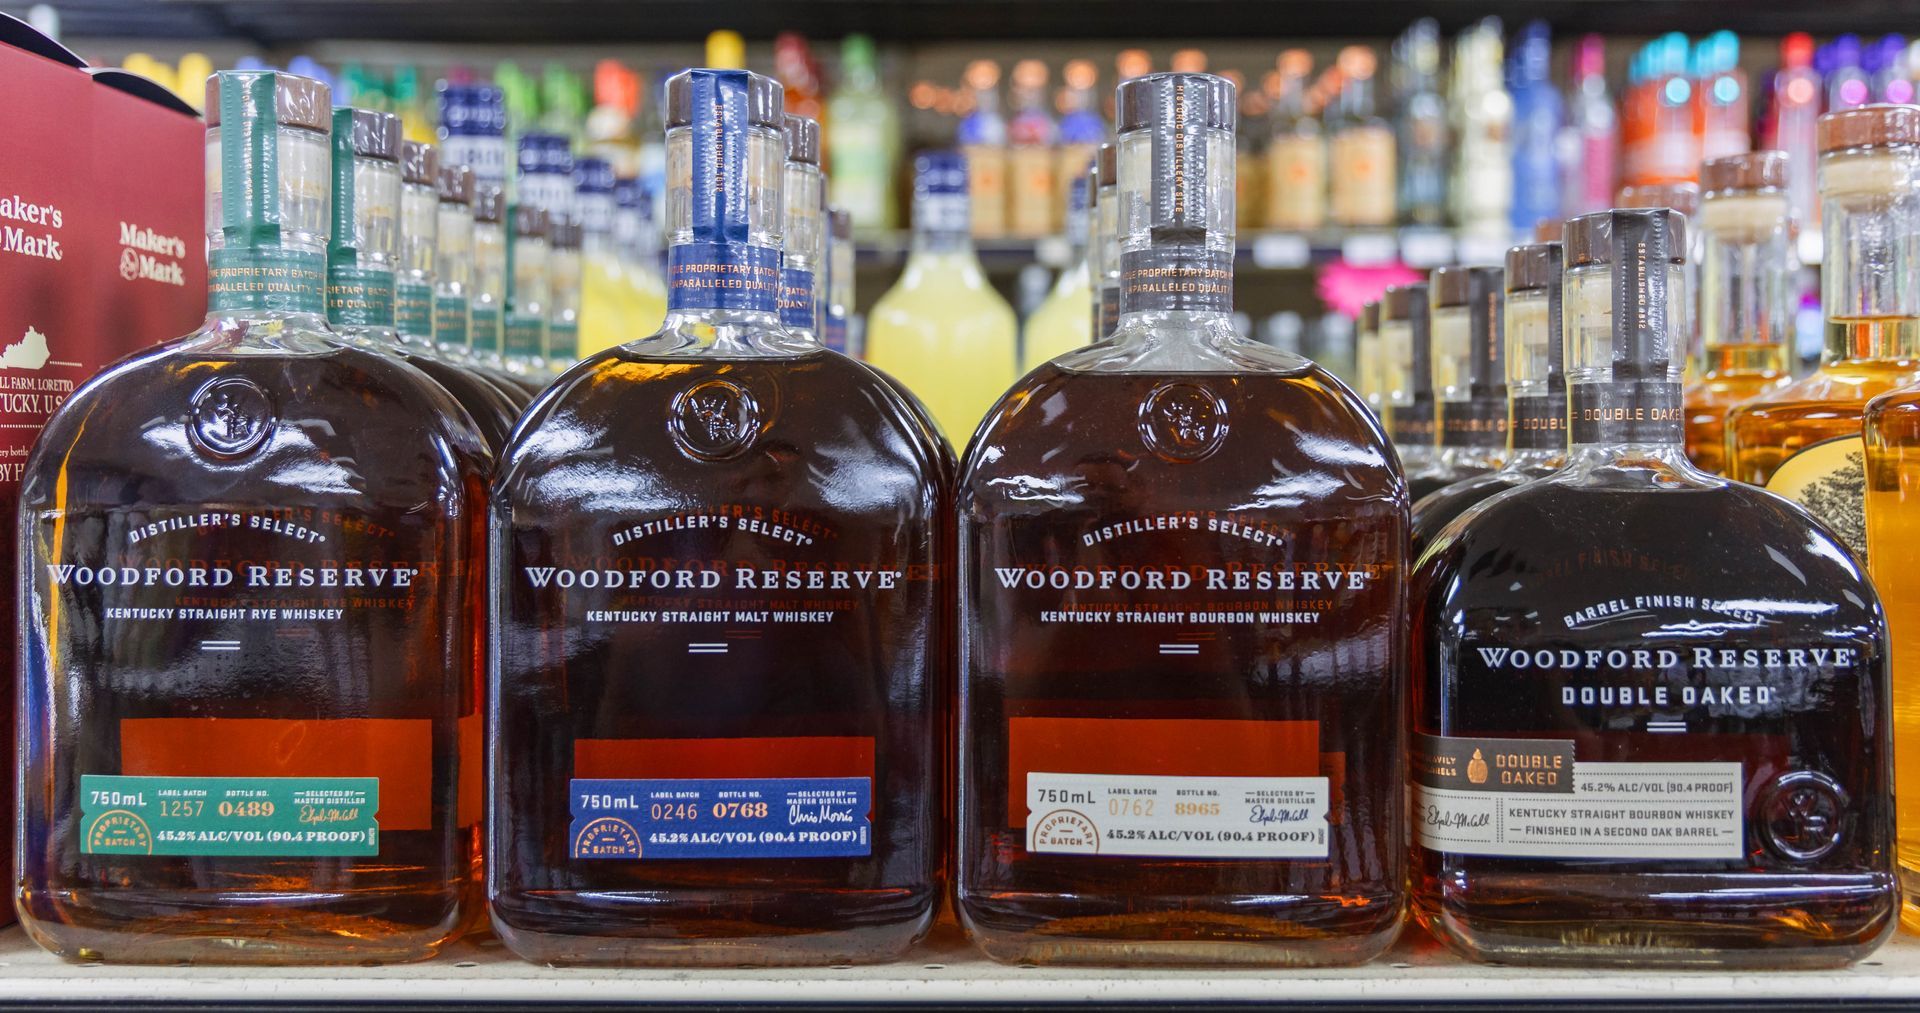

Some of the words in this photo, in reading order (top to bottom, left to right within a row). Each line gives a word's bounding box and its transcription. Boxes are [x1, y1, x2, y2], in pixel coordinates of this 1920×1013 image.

[1176, 85, 1184, 129] HISTORIC
[1176, 133, 1184, 188] DISTILLERY
[1176, 191, 1184, 213] SITE
[0, 195, 63, 229] aker's
[119, 220, 186, 259] Maker's
[138, 254, 184, 286] Mark
[221, 267, 289, 277] PROPRIETARY
[685, 264, 751, 275] PROPRIETARY
[1137, 268, 1202, 279] PROPRIETARY
[1638, 242, 1646, 306] ESTABLISHED
[1584, 408, 1644, 421] DOUBLE
[129, 513, 241, 544] DISTILLER'S
[251, 516, 320, 544] SELECT
[612, 515, 728, 546] DISTILLER'S
[738, 520, 806, 547] SELECT
[1083, 516, 1198, 547] DISTILLER'S
[1208, 518, 1276, 547] SELECT
[46, 564, 234, 586] WOODFORD
[248, 565, 412, 587] RESERVE
[525, 567, 721, 589] WOODFORD
[735, 568, 896, 590] RESERVE
[994, 568, 1192, 590] WOODFORD
[1206, 569, 1365, 590] RESERVE
[107, 607, 174, 619] KENTUCKY
[179, 608, 246, 620] STRAIGHT
[251, 608, 277, 620] RYE
[282, 608, 343, 620] WHISKEY
[587, 610, 657, 622] KENTUCKY
[662, 611, 730, 623] STRAIGHT
[735, 611, 769, 623] MALT
[773, 611, 834, 623] WHISKEY
[1040, 611, 1111, 622] KENTUCKY
[1116, 612, 1184, 623] STRAIGHT
[1190, 612, 1254, 624] BOURBON
[1259, 612, 1320, 624] WHISKEY
[1563, 599, 1630, 628] BARREL
[1635, 595, 1695, 608] FINISH
[1477, 647, 1678, 669] WOODFORD
[1693, 647, 1850, 668] RESERVE
[1562, 687, 1667, 705] DOUBLE
[1683, 686, 1770, 705] OAKED
[1496, 754, 1563, 769] DOUBLE
[1501, 771, 1557, 785] OAKED
[798, 790, 835, 798] SELECTED
[1581, 782, 1615, 793] 45.2%
[1618, 782, 1664, 794] ALC/VOL
[91, 790, 147, 806] 750mL
[581, 794, 639, 809] 750mL
[819, 797, 857, 805] DISTILLER
[1038, 789, 1096, 804] 750mL
[160, 800, 204, 817] 1257
[218, 801, 275, 817] 0489
[651, 803, 698, 820] 0246
[713, 802, 768, 819] 0768
[789, 804, 817, 825] Chris
[819, 805, 853, 823] Morris
[1108, 799, 1154, 816] 0762
[1174, 803, 1220, 816] 8965
[1509, 807, 1566, 819] KENTUCKY
[1570, 809, 1625, 819] STRAIGHT
[1629, 809, 1681, 820] BOURBON
[1686, 810, 1734, 820] WHISKEY
[94, 816, 146, 847] PROPRIETARY
[157, 830, 196, 841] 45.2%
[198, 830, 264, 842] ALC/VOL
[267, 830, 303, 842] (90.4
[306, 830, 366, 842] PROOF)
[582, 824, 636, 854] PROPRIETARY
[649, 832, 688, 843] 45.2%
[690, 831, 757, 844] ALC/VOL
[759, 831, 796, 843] (90.4
[798, 830, 857, 842] PROOF)
[1040, 816, 1094, 846] PROPRIETARY
[1107, 829, 1145, 840] 45.2%
[1147, 830, 1214, 842] ALC/VOL
[1217, 831, 1253, 842] (90.4
[1257, 831, 1315, 842] PROOF)
[1526, 826, 1576, 836] FINISHED
[1580, 827, 1591, 836] IN
[1594, 827, 1601, 836] A
[1604, 827, 1648, 837] SECOND
[1651, 827, 1672, 837] OAK
[1676, 827, 1718, 837] BARREL
[105, 838, 136, 847] BATCH
[593, 845, 625, 854] BATCH
[1050, 837, 1082, 846] BATCH
